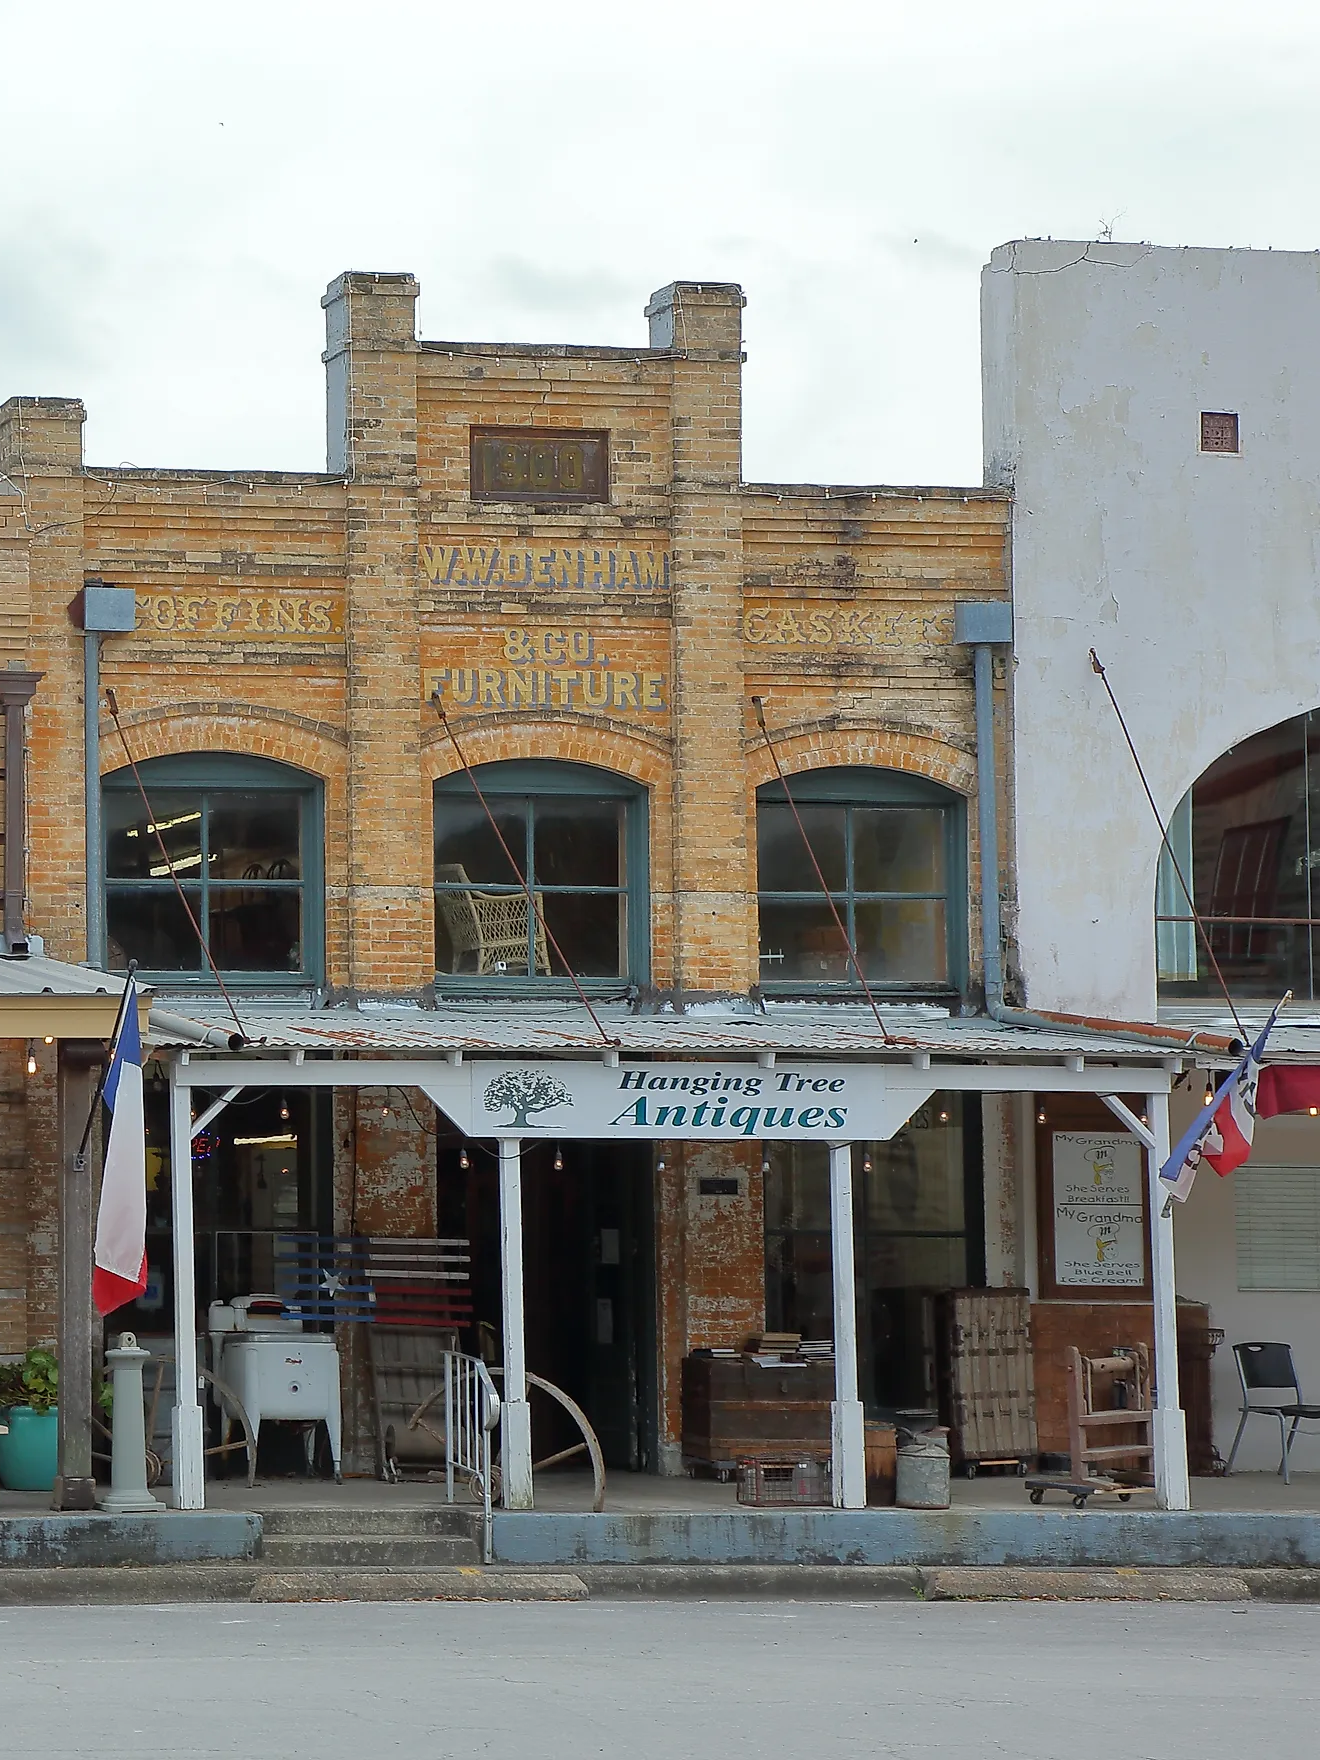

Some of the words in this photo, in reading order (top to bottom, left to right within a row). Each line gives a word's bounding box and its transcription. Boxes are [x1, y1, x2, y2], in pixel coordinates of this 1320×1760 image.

[424, 668, 668, 712] FURNITURE
[616, 1070, 765, 1096] Hanging
[775, 1072, 846, 1092] Tree
[607, 1095, 848, 1136] Antiques
[1055, 1134, 1075, 1143] My
[1065, 1184, 1088, 1193] She
[1090, 1184, 1130, 1194] Serves
[1056, 1206, 1076, 1219] My
[1093, 1261, 1141, 1269] Serves
[1060, 1276, 1088, 1284] Ice
